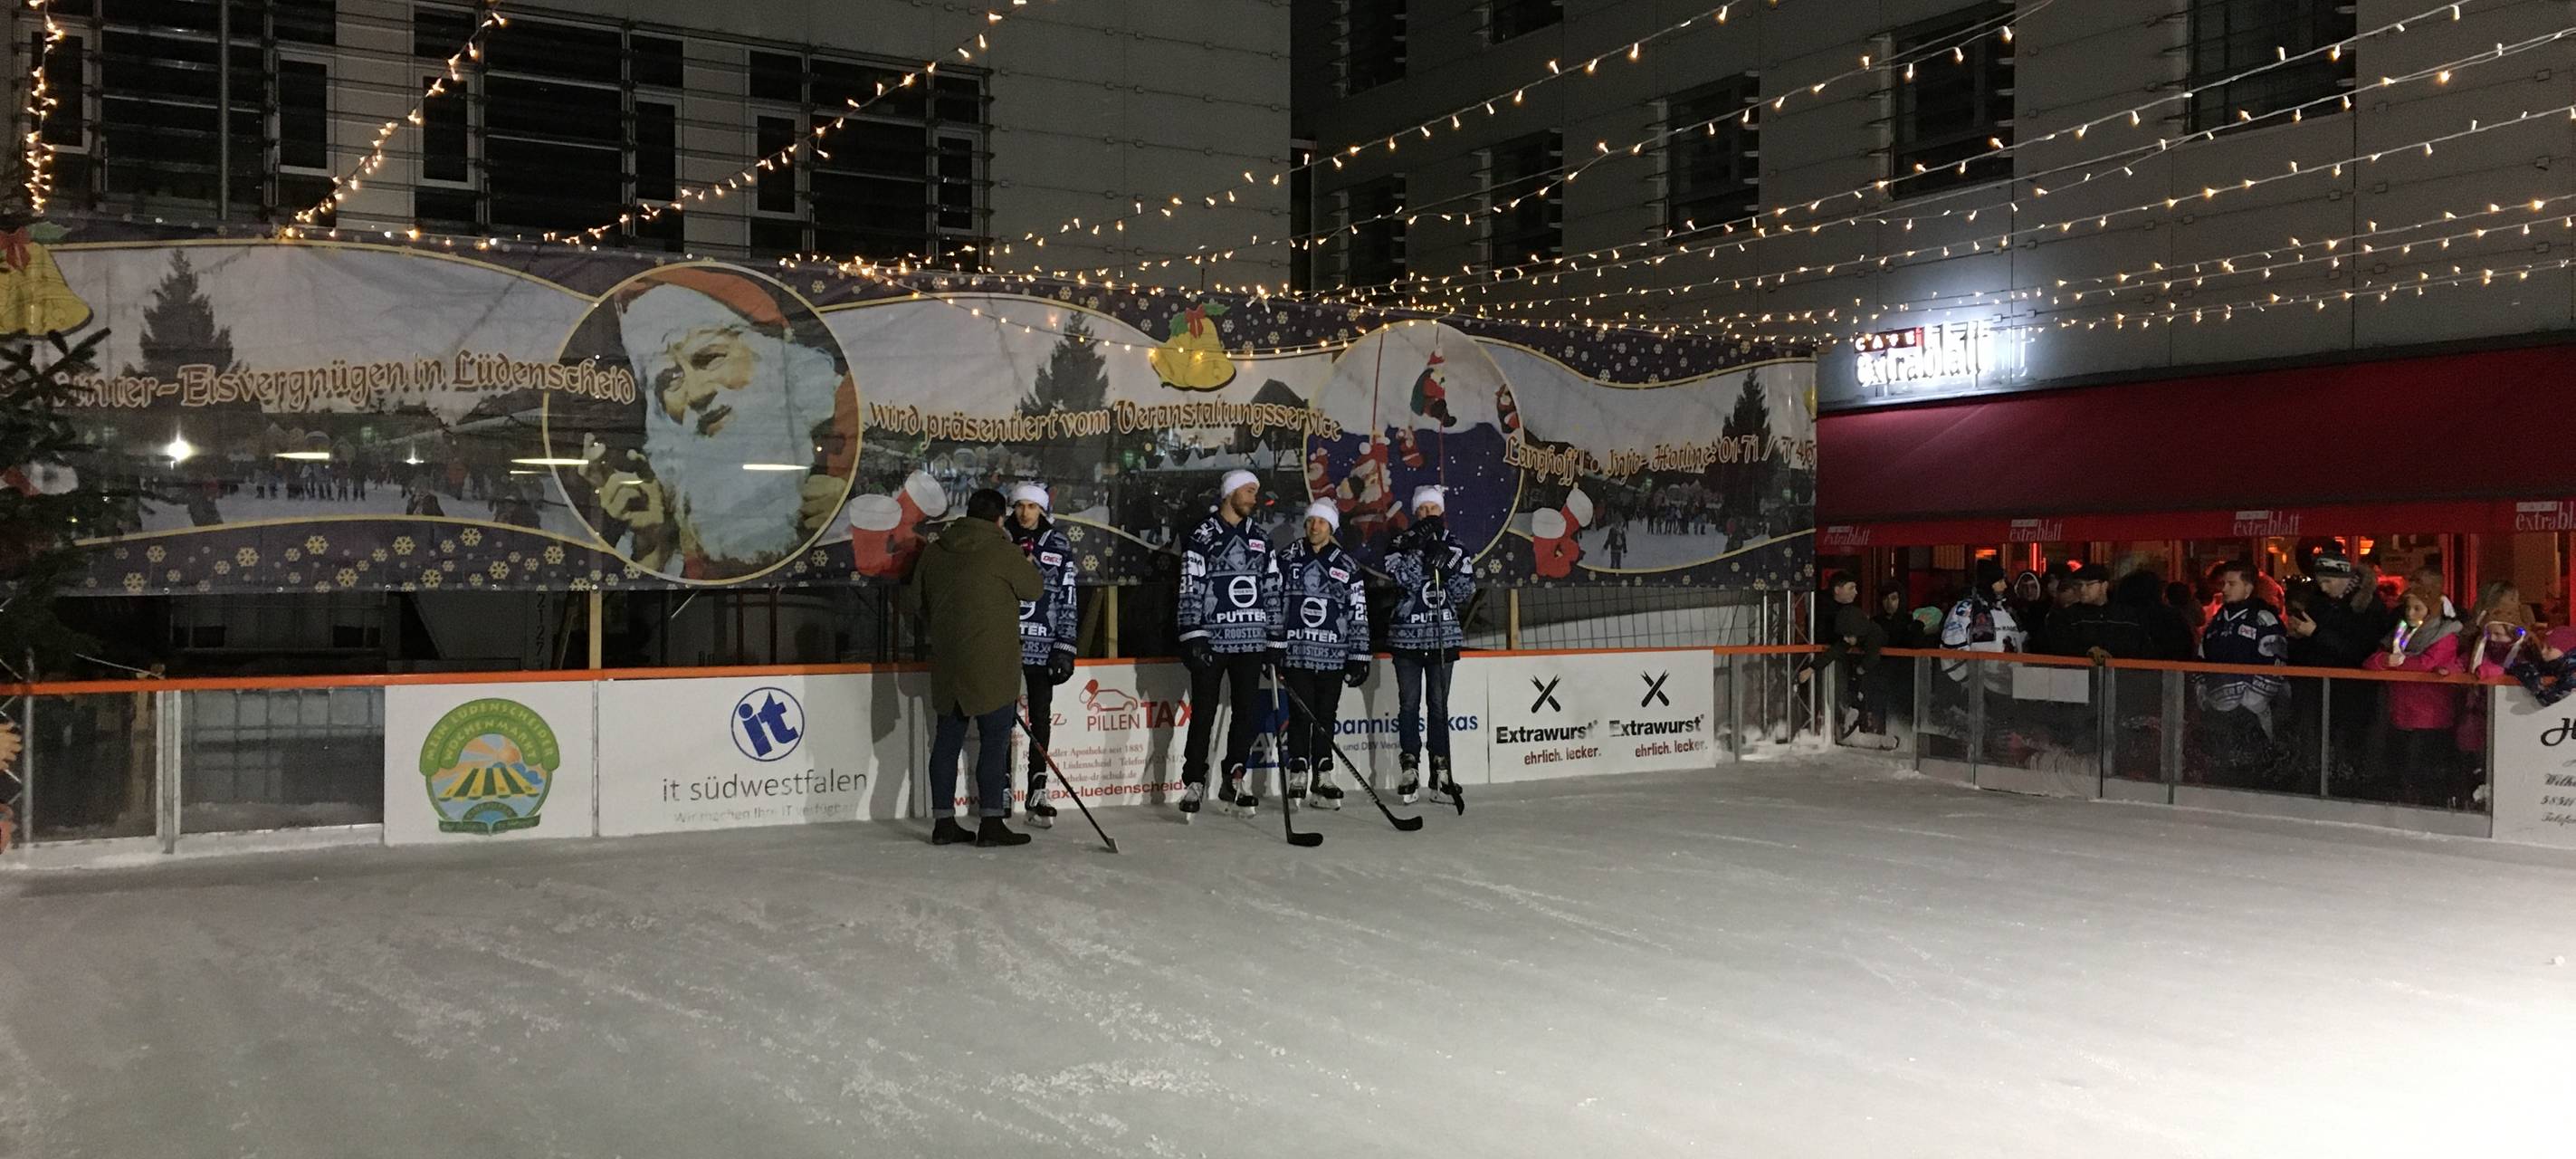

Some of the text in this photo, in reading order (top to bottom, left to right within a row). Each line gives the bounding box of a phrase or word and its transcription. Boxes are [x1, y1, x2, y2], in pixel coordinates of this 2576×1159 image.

[414, 353, 445, 391] in
[452, 350, 635, 405] Lüdenscheid
[919, 407, 1059, 451] präsentiert
[1060, 409, 1110, 437] vom
[1114, 395, 1345, 441] Veranstaltungsservice
[2009, 519, 2064, 542] extrablatt
[2233, 511, 2304, 536] extrablatt
[1216, 611, 1266, 623] PUTTER
[1287, 628, 1338, 643] PUTTER
[1609, 716, 1702, 737] Extrawurst
[1524, 745, 1601, 765] ehrlich. lecker.
[1635, 738, 1708, 758] ehrlich. lecker.
[663, 768, 867, 802] it südwestfalen
